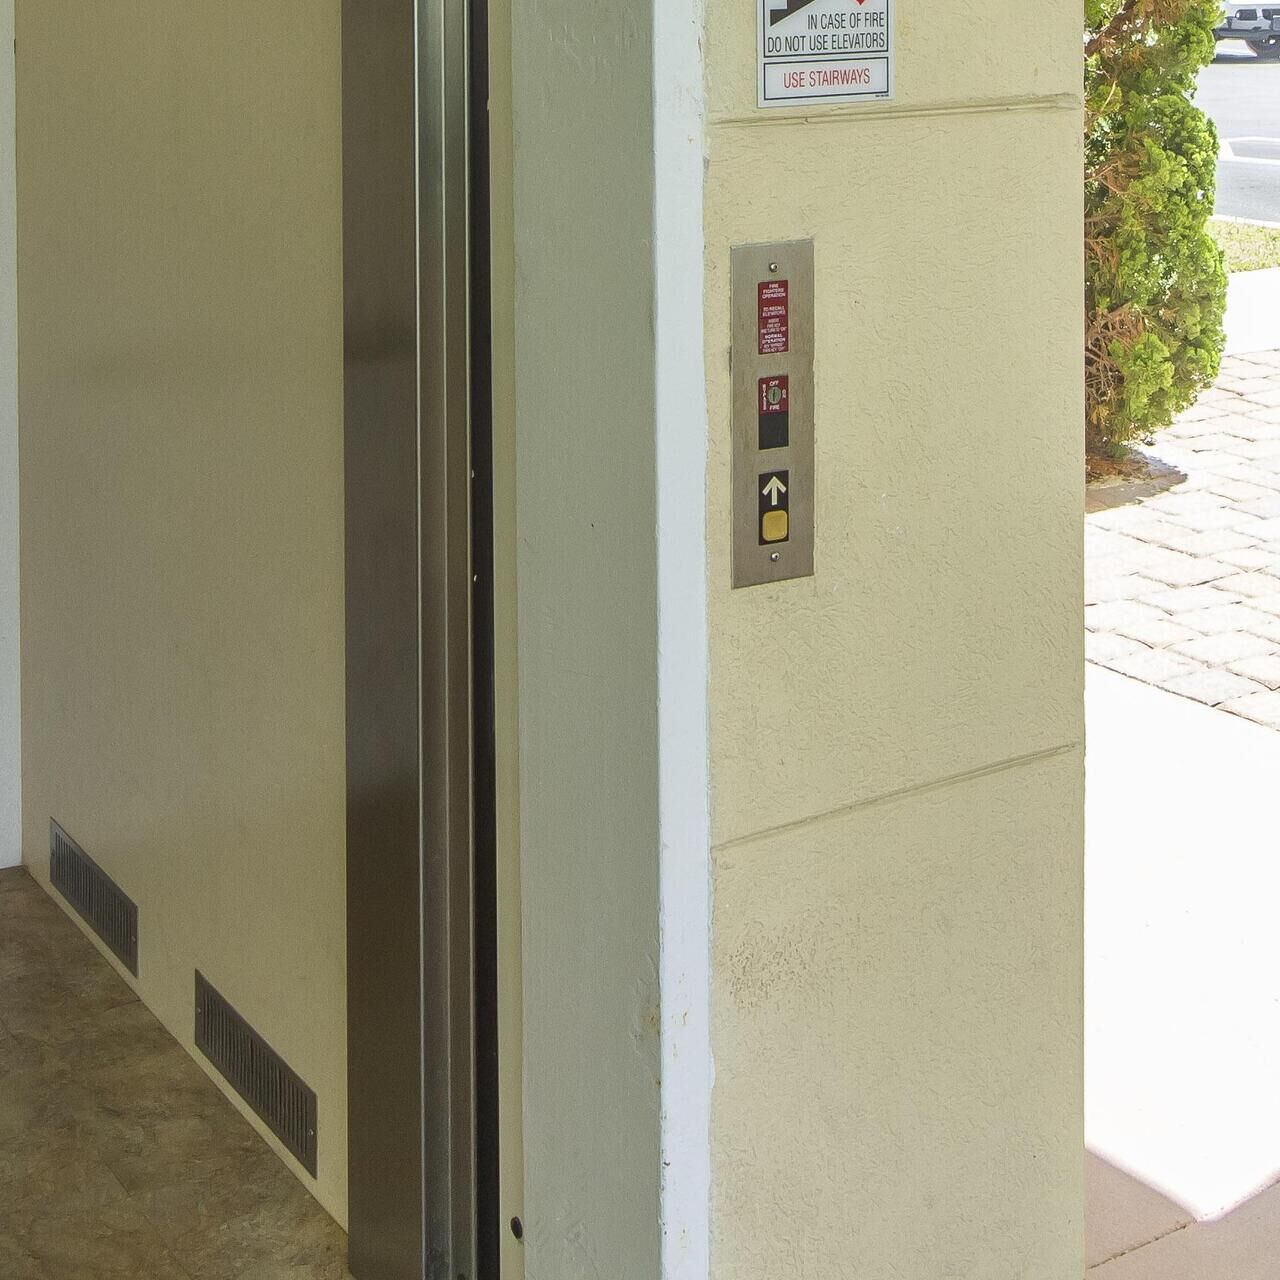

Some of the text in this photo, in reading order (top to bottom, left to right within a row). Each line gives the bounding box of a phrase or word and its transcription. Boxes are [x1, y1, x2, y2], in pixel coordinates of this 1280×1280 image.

[807, 11, 885, 30] IN CASE OF FIRE
[767, 32, 885, 53] DO NOT USE ELEVATORS
[783, 68, 870, 88] USE STAIRWAYS
